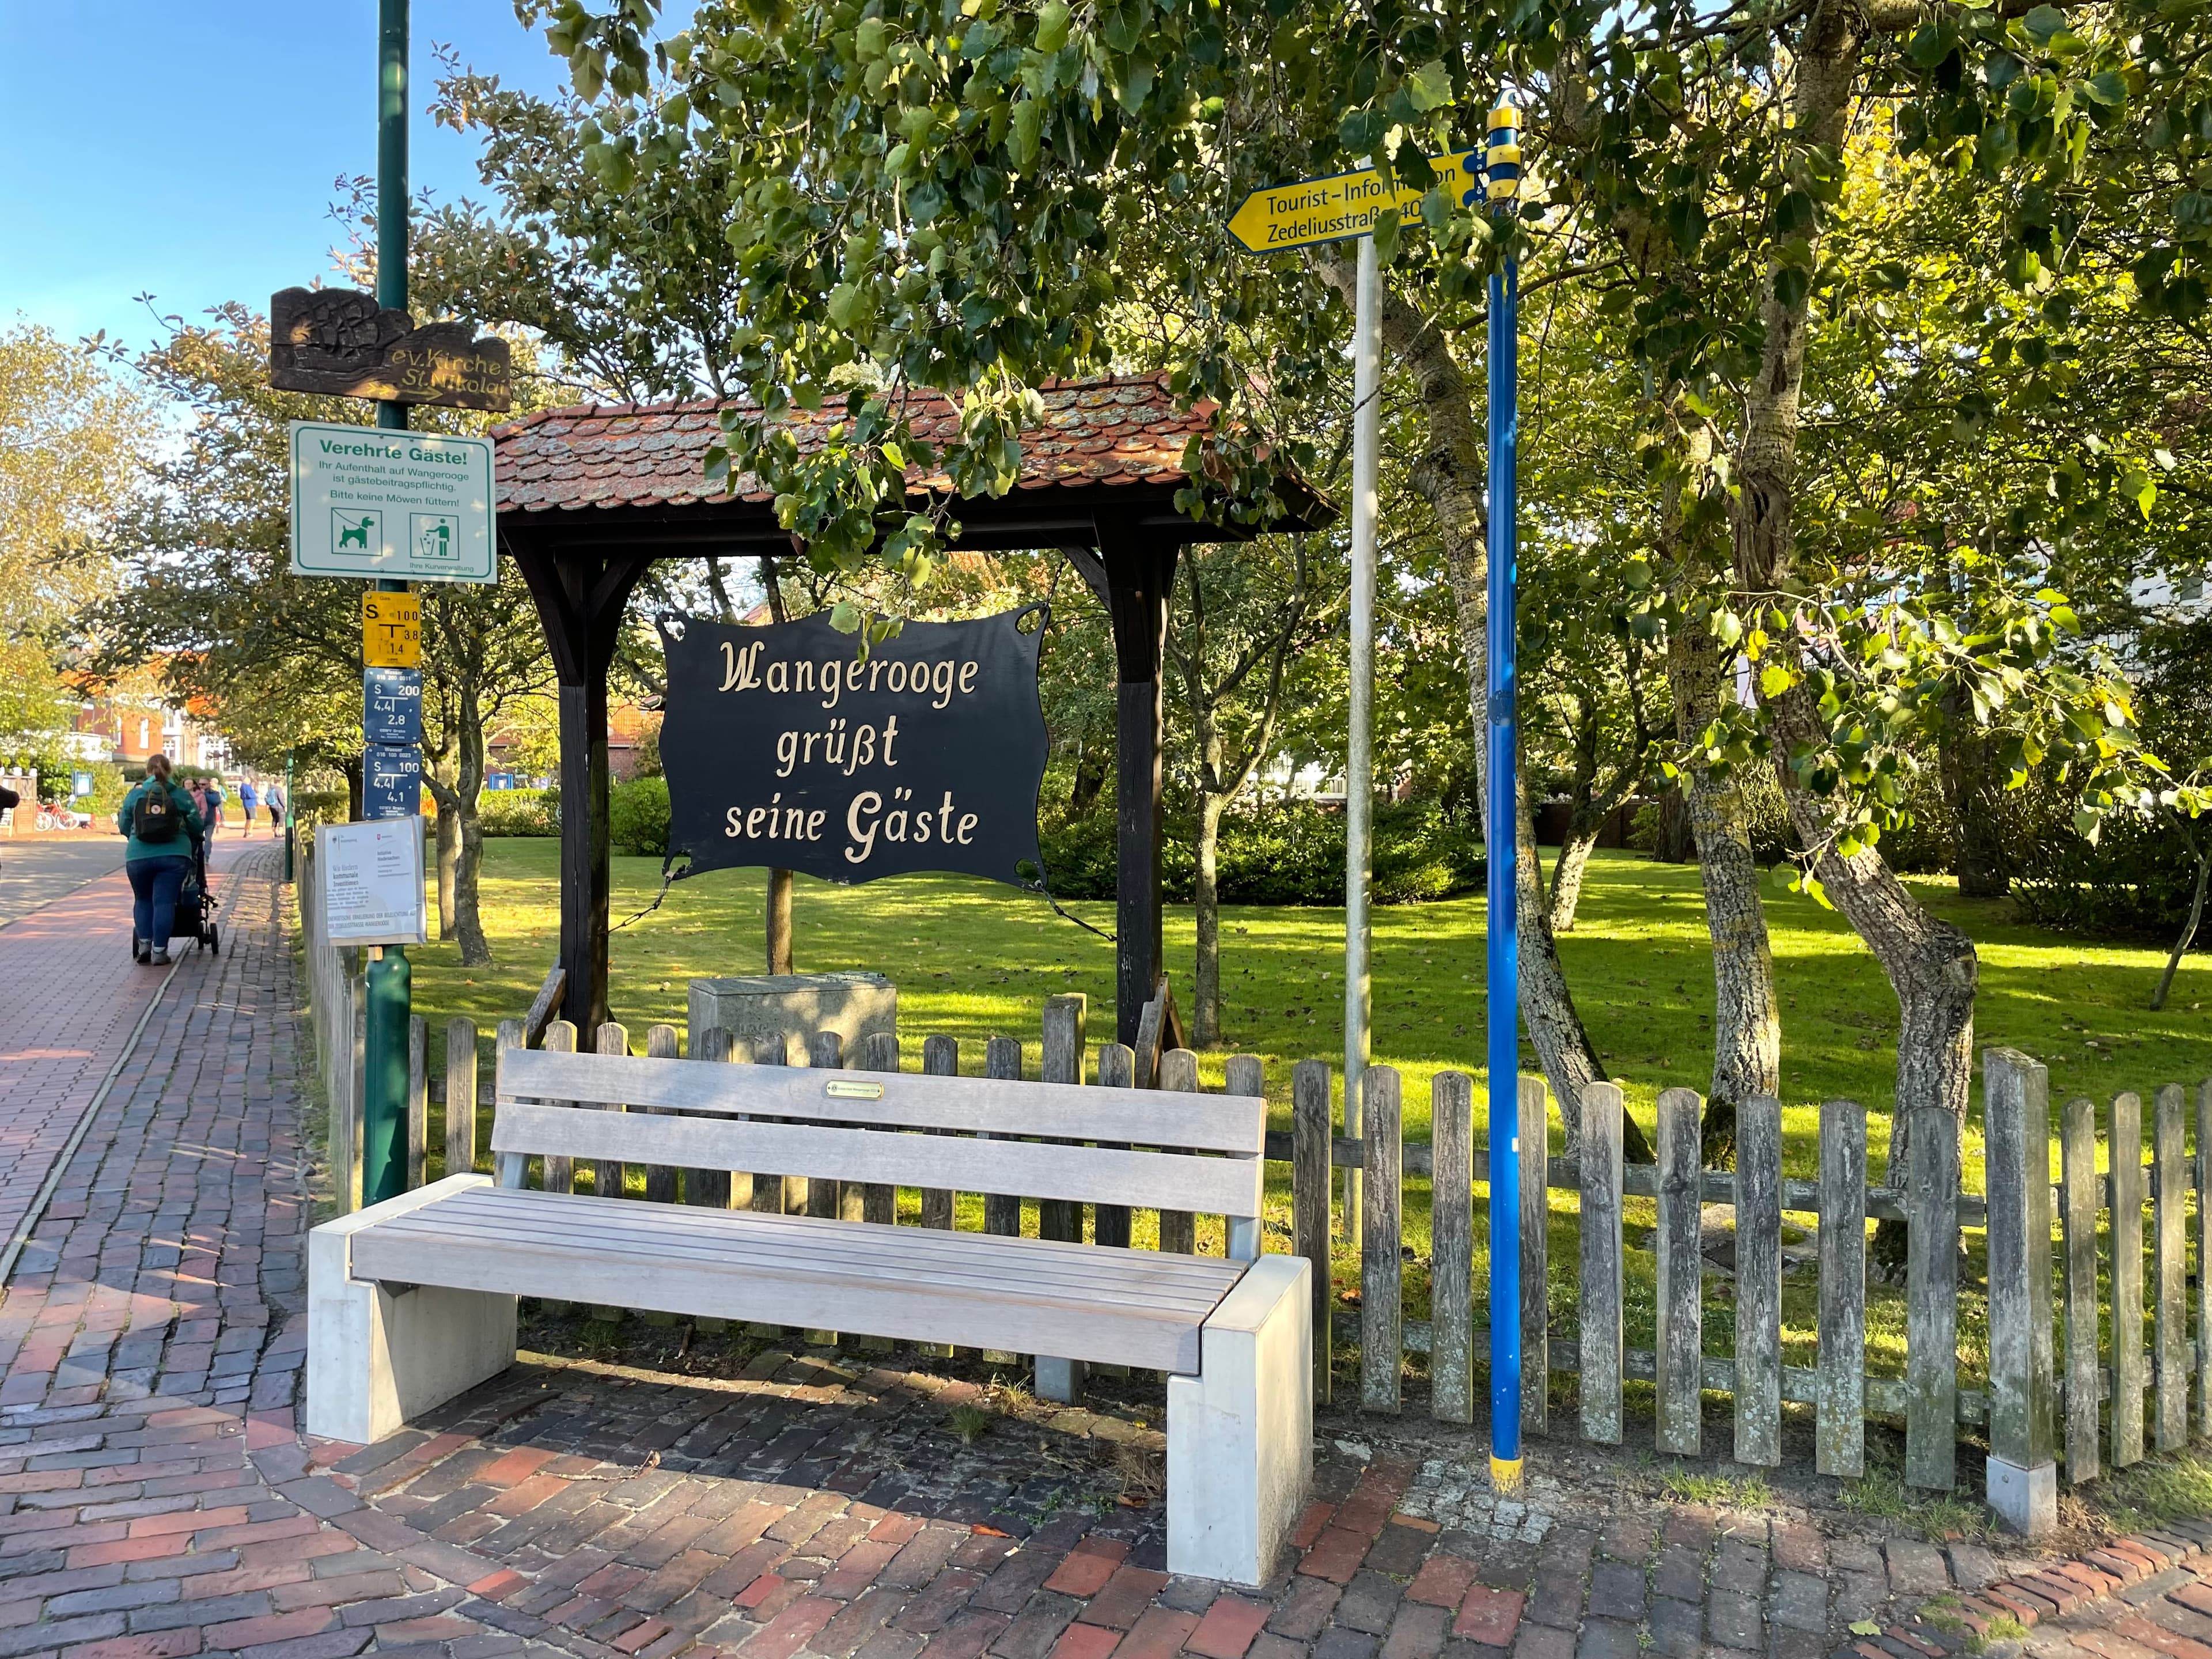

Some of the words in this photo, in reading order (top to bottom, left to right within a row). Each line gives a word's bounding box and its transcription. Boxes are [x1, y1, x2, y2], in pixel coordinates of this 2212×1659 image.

[1267, 206, 1380, 243] Zedeliusstraß
[320, 439, 402, 459] Verehrte
[409, 448, 467, 465] Gäste!
[319, 460, 332, 469] Ihr
[335, 462, 387, 474] Aufenthalt
[389, 467, 404, 475] auf
[407, 467, 469, 482] Wangerooge
[333, 474, 344, 483] ist
[348, 475, 456, 493] gästebeitragspflichtig.
[330, 490, 354, 499] Bitte
[357, 492, 383, 502] keine
[387, 494, 422, 505] Möwen
[426, 497, 460, 507] füttern!
[425, 563, 474, 573] Kurverwaltung
[366, 604, 378, 619] S
[397, 611, 418, 621] 100
[718, 641, 979, 709] Wangerooge
[374, 684, 381, 694] S
[398, 685, 419, 696] 200
[374, 700, 391, 711] 4,4
[388, 714, 405, 725] 2,8
[776, 715, 899, 778] grüßt
[374, 761, 381, 771] S
[399, 762, 419, 772] 100
[373, 778, 391, 789] 4,4
[387, 791, 404, 802] 4,1
[725, 793, 827, 842] seine
[844, 786, 979, 863] Gäste
